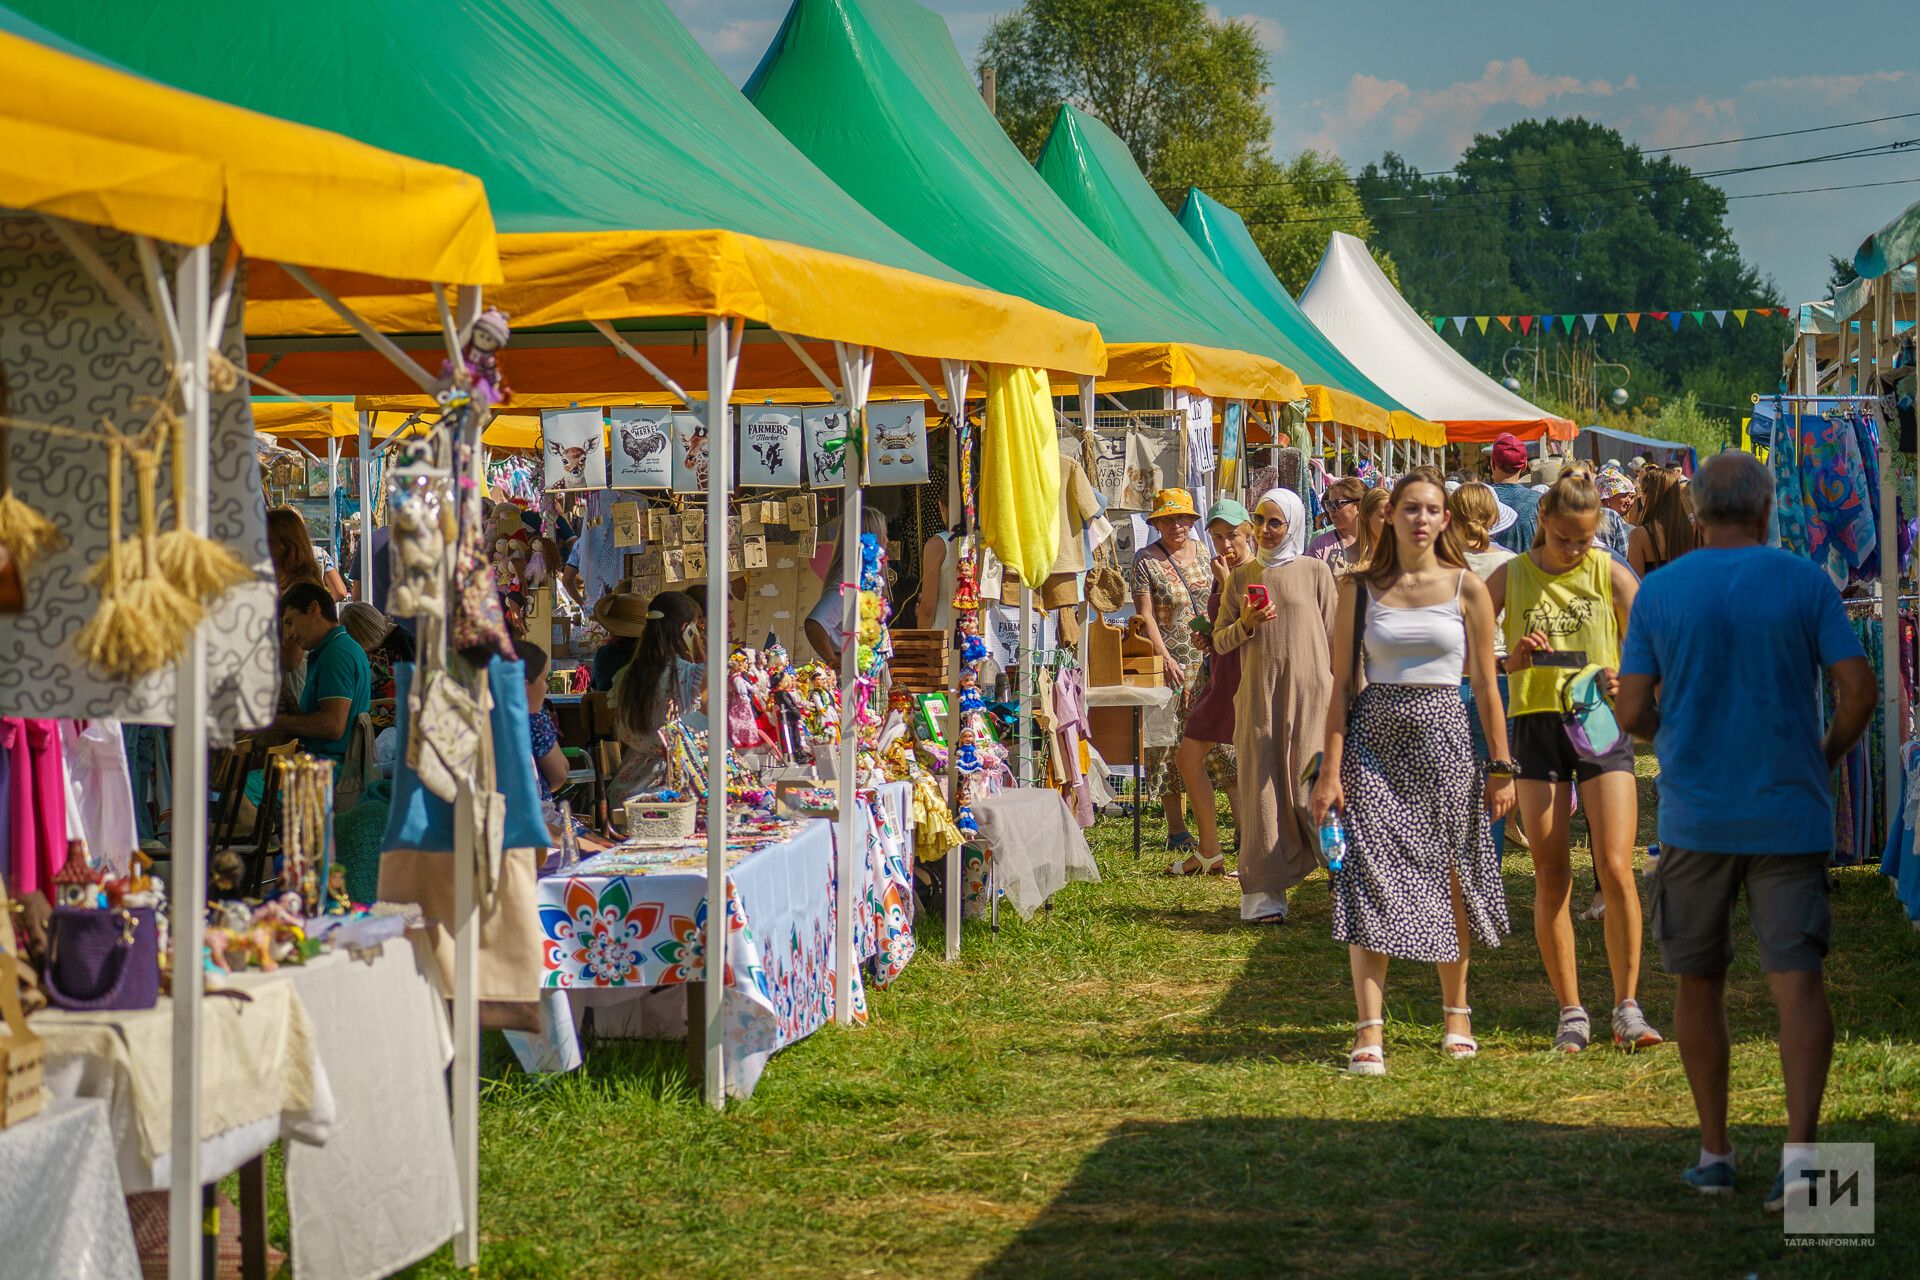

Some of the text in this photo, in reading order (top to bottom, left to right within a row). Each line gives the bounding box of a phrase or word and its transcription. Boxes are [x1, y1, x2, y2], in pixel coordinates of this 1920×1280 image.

[634, 425, 659, 438] MARKET
[748, 424, 788, 435] FARMERS
[1098, 467, 1124, 477] WAS
[998, 621, 1037, 634] FARMS
